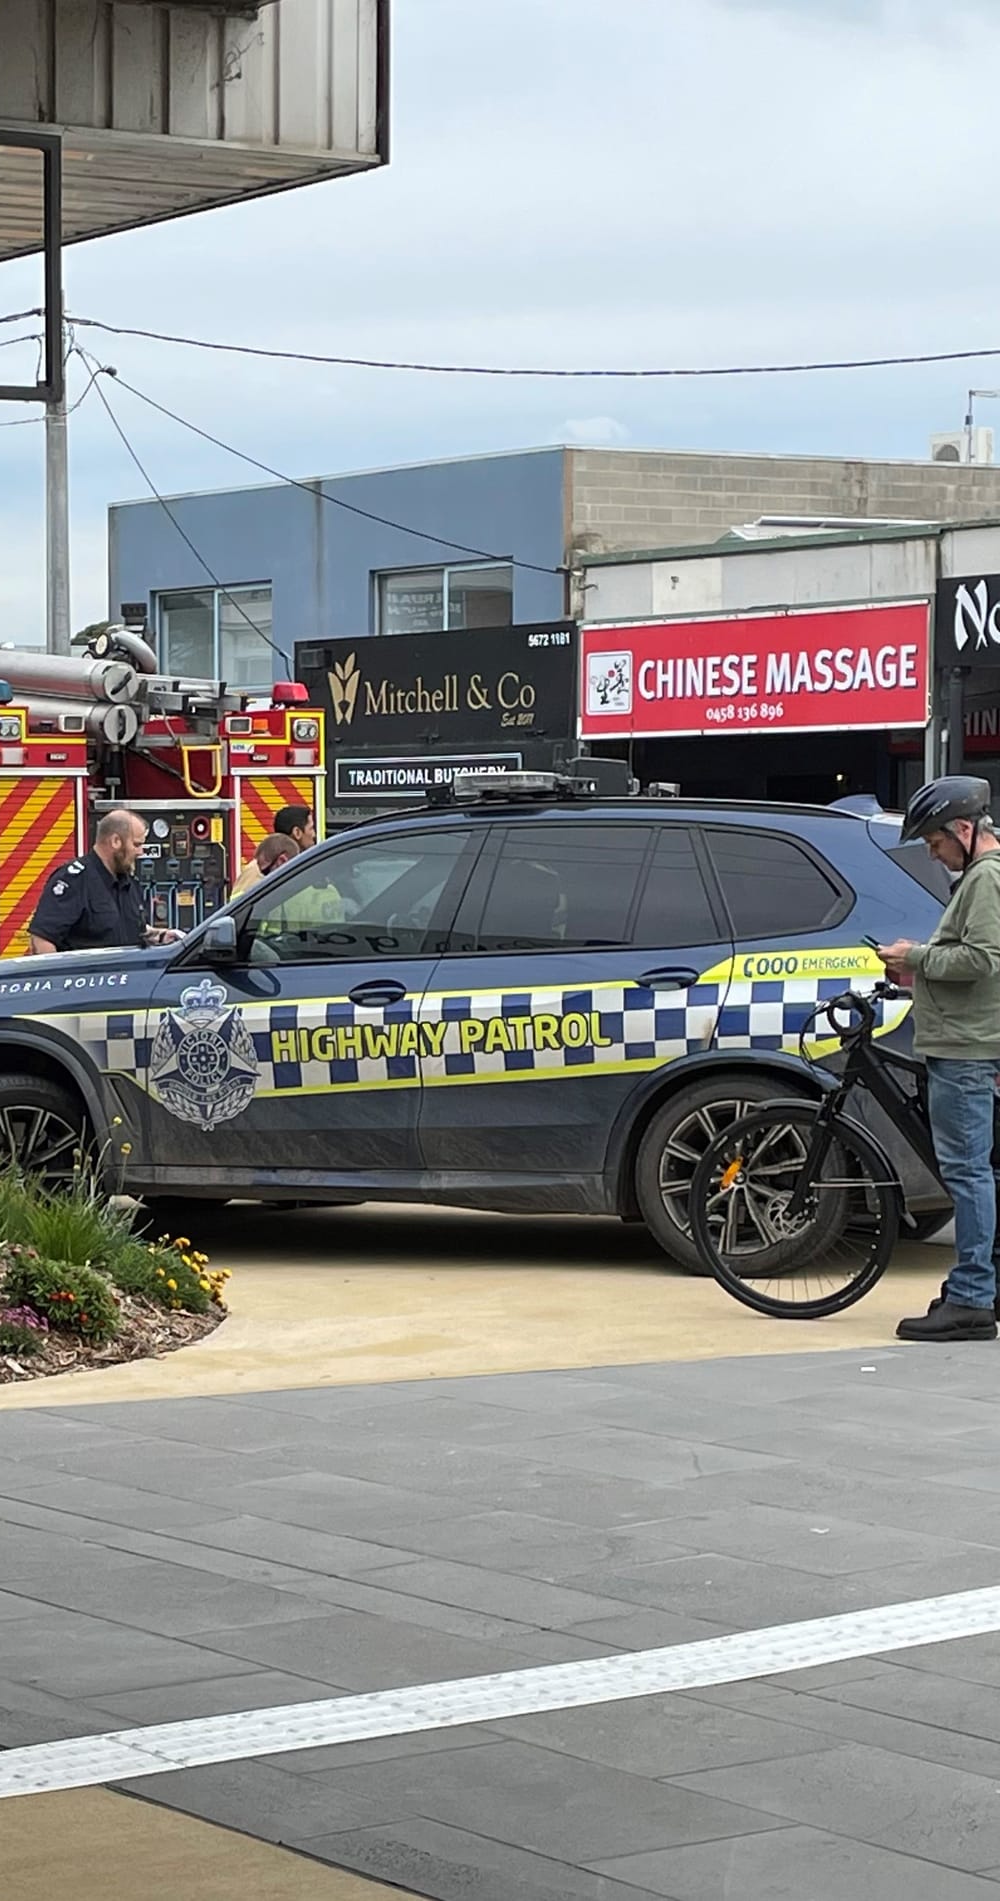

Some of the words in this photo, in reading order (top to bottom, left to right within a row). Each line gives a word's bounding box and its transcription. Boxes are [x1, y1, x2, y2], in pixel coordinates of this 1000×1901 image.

[528, 633, 549, 647] 5672
[638, 654, 757, 700] CHINESE
[765, 644, 918, 695] MASSAGE
[364, 674, 459, 716] Mitchell
[467, 674, 492, 710] &
[498, 671, 536, 709] Co
[706, 704, 735, 721] 0458
[737, 703, 757, 720] 136
[760, 702, 784, 720] 896
[349, 768, 432, 786] TRADITIONAL
[757, 956, 798, 976] 000
[802, 956, 870, 969] EMERGENCY
[64, 974, 128, 989] POLICE
[179, 1031, 228, 1056] VICTORIA
[271, 1022, 447, 1064] HIGHWAY
[459, 1011, 612, 1054] PATROL
[184, 1067, 226, 1086] POLICE
